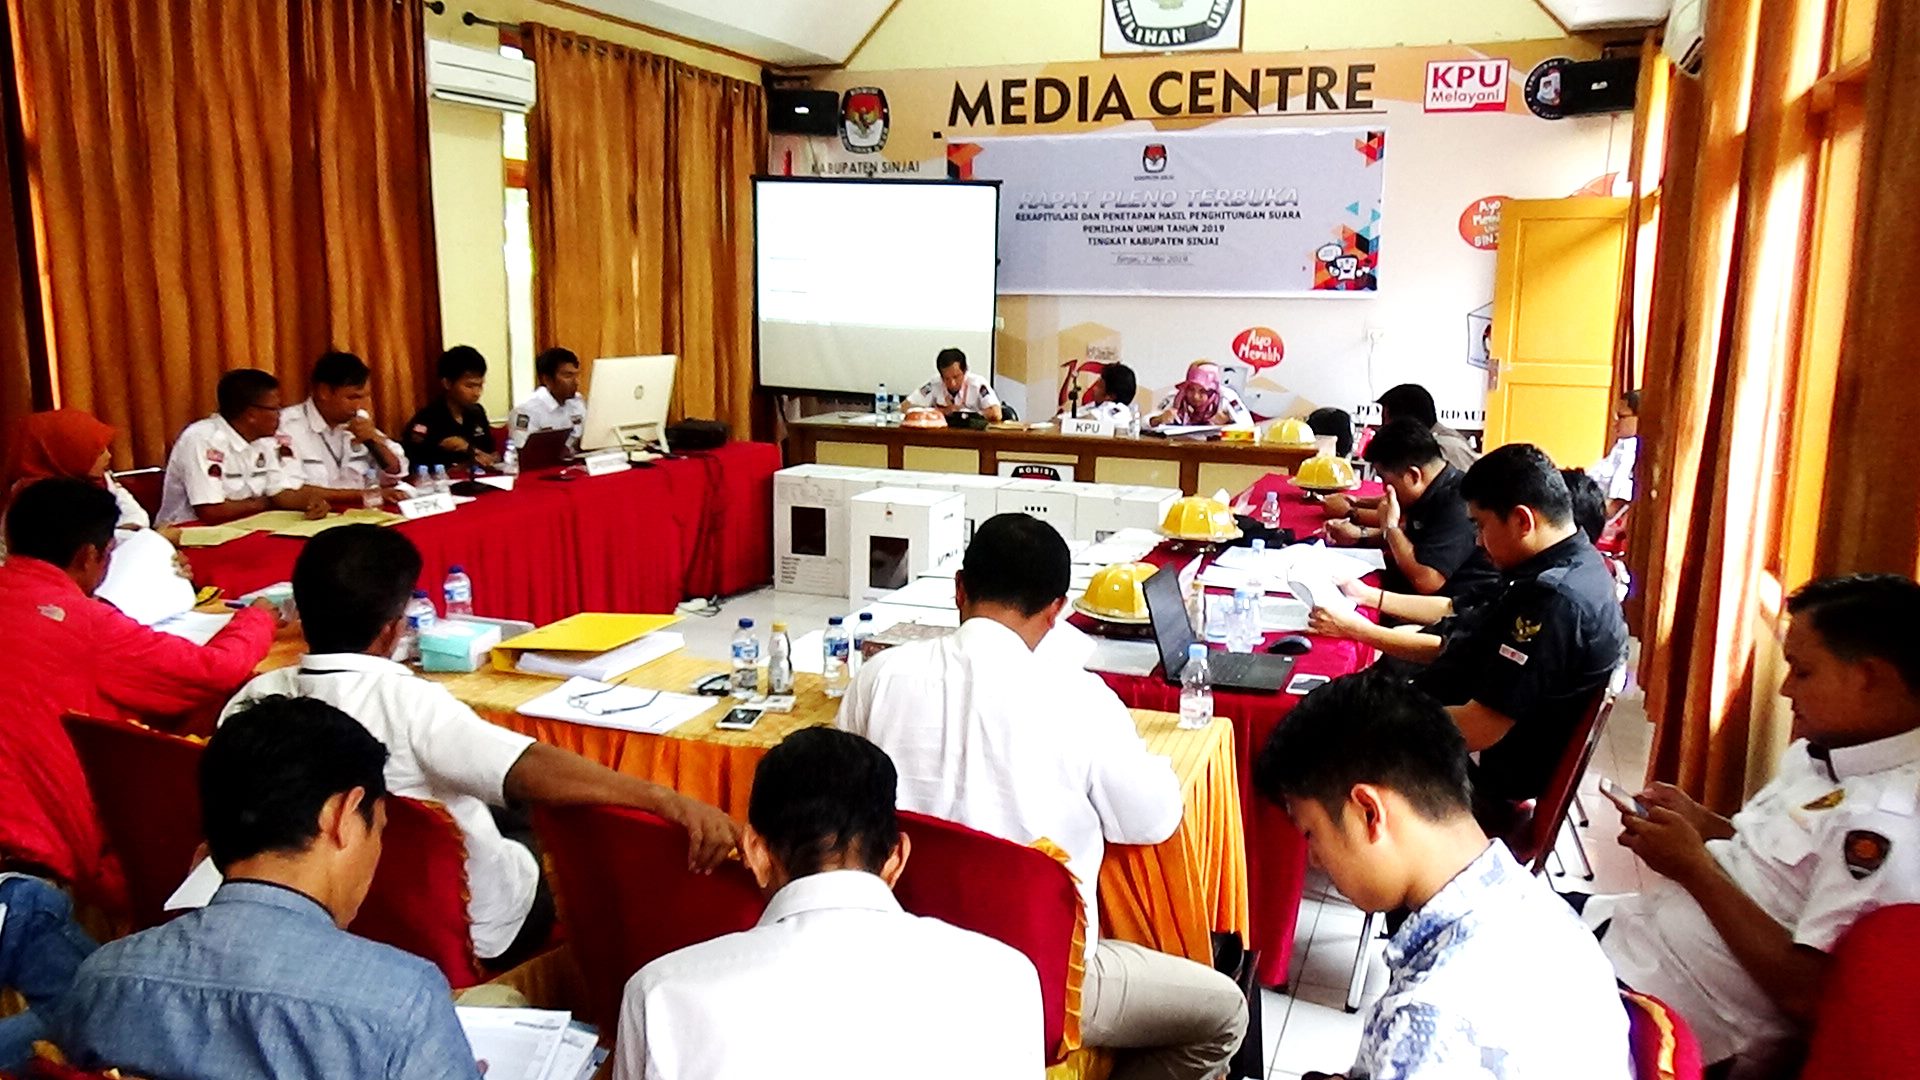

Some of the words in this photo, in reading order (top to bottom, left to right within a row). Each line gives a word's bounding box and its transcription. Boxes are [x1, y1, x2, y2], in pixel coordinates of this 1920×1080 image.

[1115, 0, 1186, 44] MILIHAN
[1432, 64, 1501, 89] KPU
[948, 75, 1135, 127] MEDIA
[1149, 64, 1376, 117] CENTRE
[1430, 89, 1500, 104] Melayani
[811, 162, 878, 175] KABUPATEN
[1018, 190, 1095, 210] RAPAT
[1100, 188, 1178, 209] PLENO
[1187, 187, 1299, 208] TERBUKA
[1015, 212, 1079, 221] REKAPITULASI
[1081, 211, 1100, 221] DAN
[1102, 211, 1156, 221] PENETAPAN
[1158, 211, 1187, 220] HASIL
[1189, 210, 1265, 220] PENGHITUNGAN
[1268, 210, 1301, 219] SUARA
[1083, 224, 1134, 233] PEMILIHAN
[1136, 224, 1164, 233] UMUM
[1167, 224, 1199, 233] TAHUN
[1201, 223, 1225, 233] 2019
[1088, 237, 1127, 246] TINGKAT
[1130, 236, 1184, 246] KABUPATEN
[1186, 236, 1219, 246] SINJAI
[1247, 329, 1272, 350] Ayo
[1075, 423, 1100, 433] KPU
